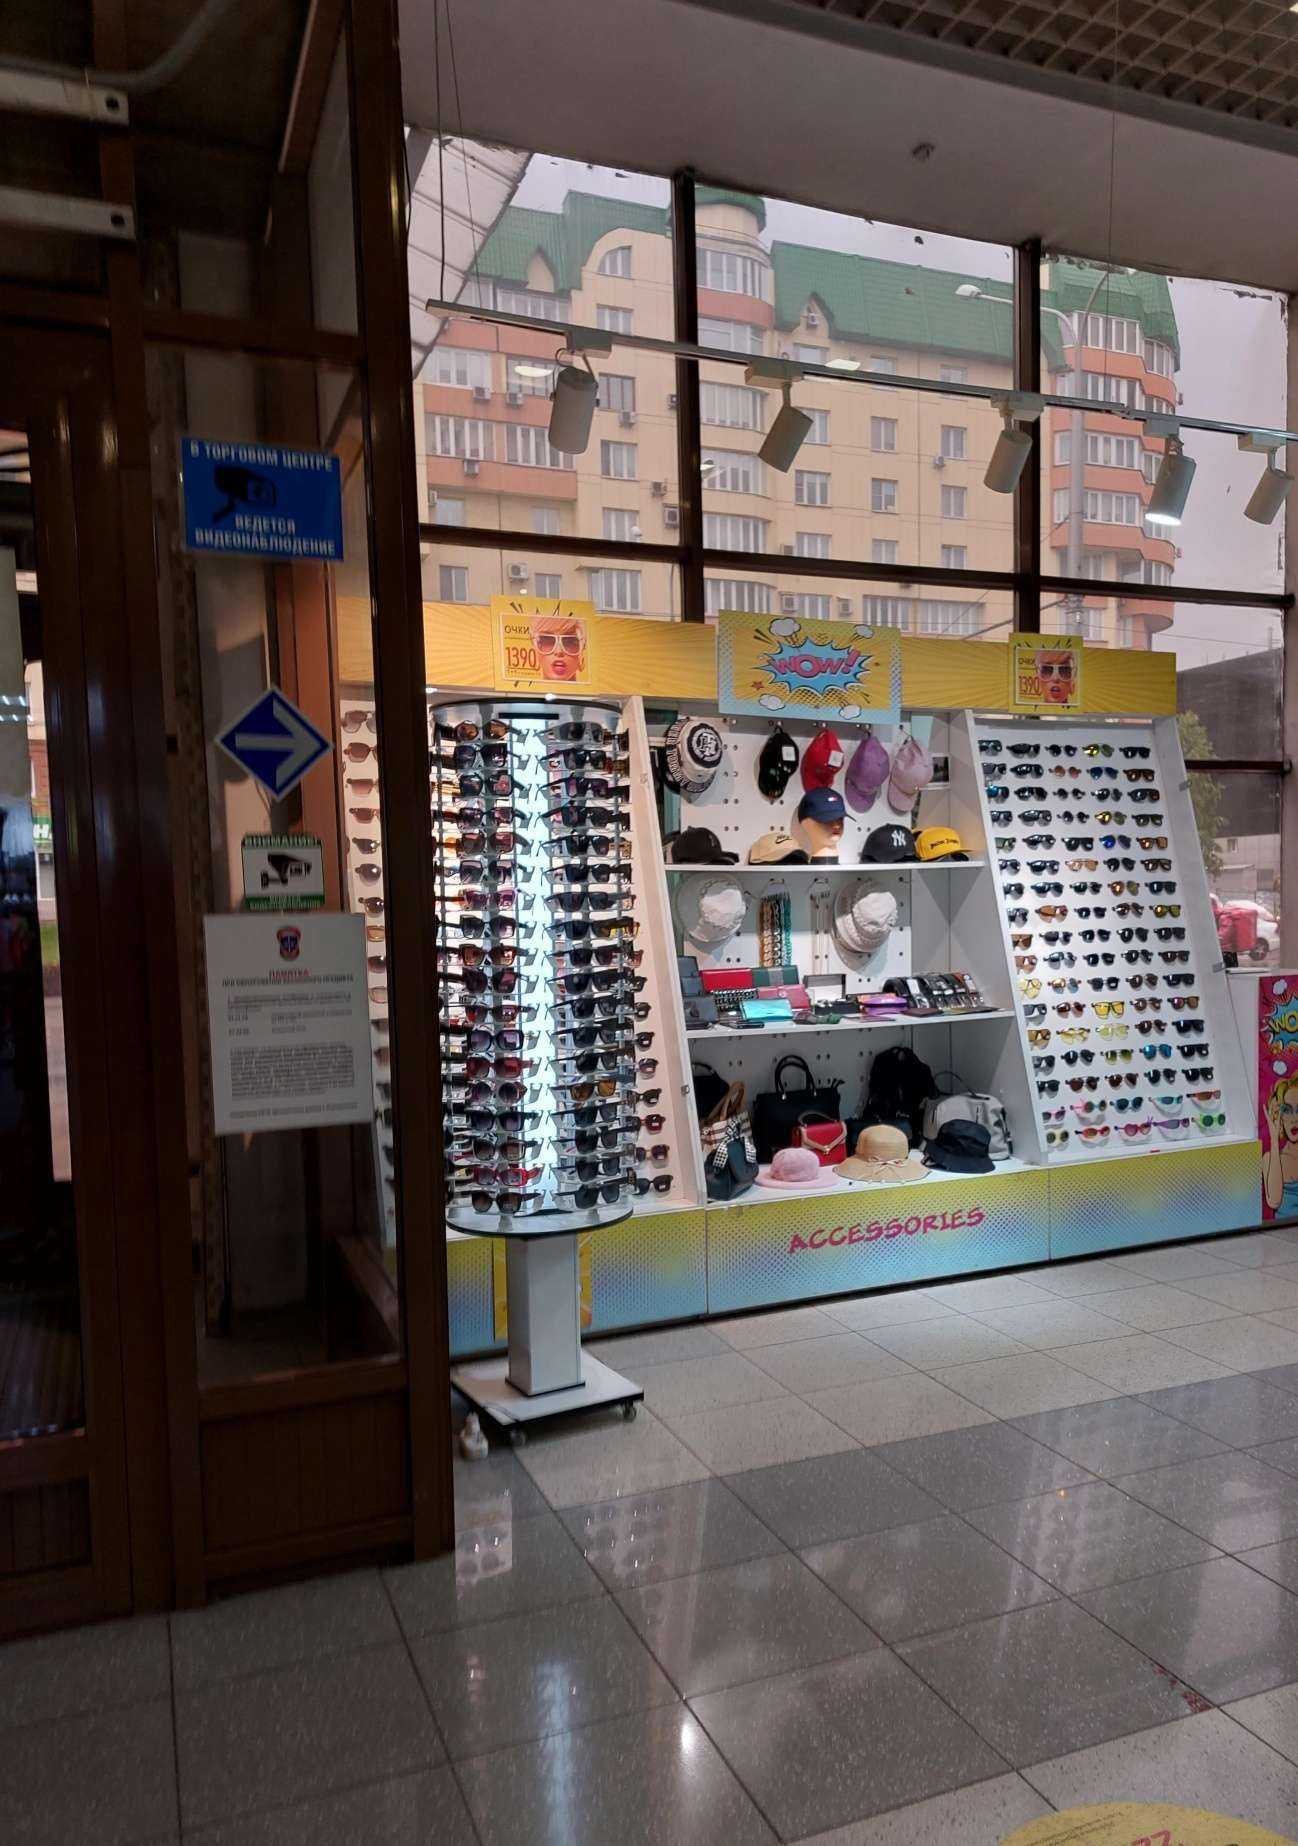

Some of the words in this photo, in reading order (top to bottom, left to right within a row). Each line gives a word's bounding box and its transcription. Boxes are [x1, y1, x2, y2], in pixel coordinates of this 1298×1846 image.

[190, 440, 199, 458] В
[205, 443, 278, 467] ТОРГОВОМ
[283, 454, 333, 472] ЦЕНТРЕ
[235, 514, 297, 535] ВЕДЕТСЯ
[195, 527, 336, 556] ВИДЕОНАБЛЮДЕНИЕ
[504, 625, 530, 635] ОЧКИ
[505, 646, 537, 668] 1390
[769, 648, 861, 678] WOW!
[789, 1207, 987, 1254] ACCESSORIES
